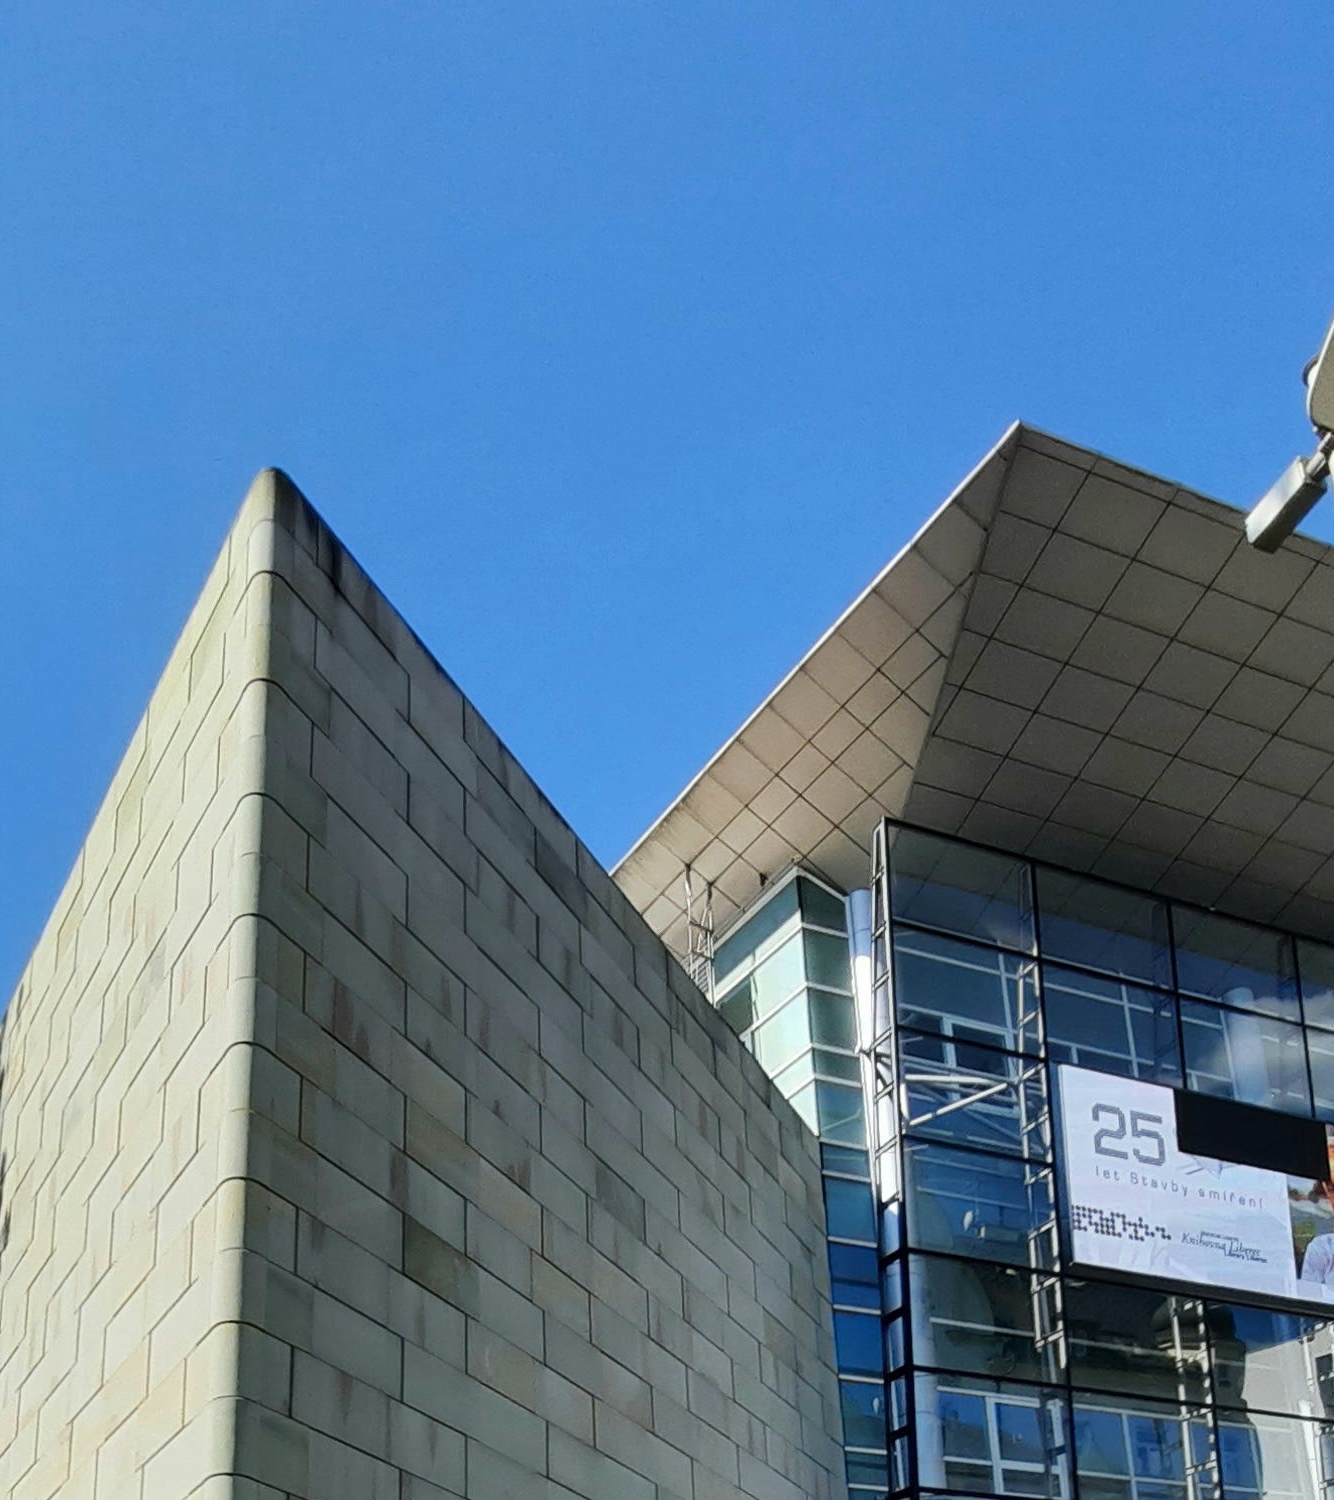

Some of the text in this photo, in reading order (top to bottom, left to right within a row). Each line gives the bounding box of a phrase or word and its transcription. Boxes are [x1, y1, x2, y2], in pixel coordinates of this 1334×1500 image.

[1092, 1102, 1166, 1167] 25
[1095, 1165, 1120, 1181] let
[1130, 1172, 1188, 1197] Stavby
